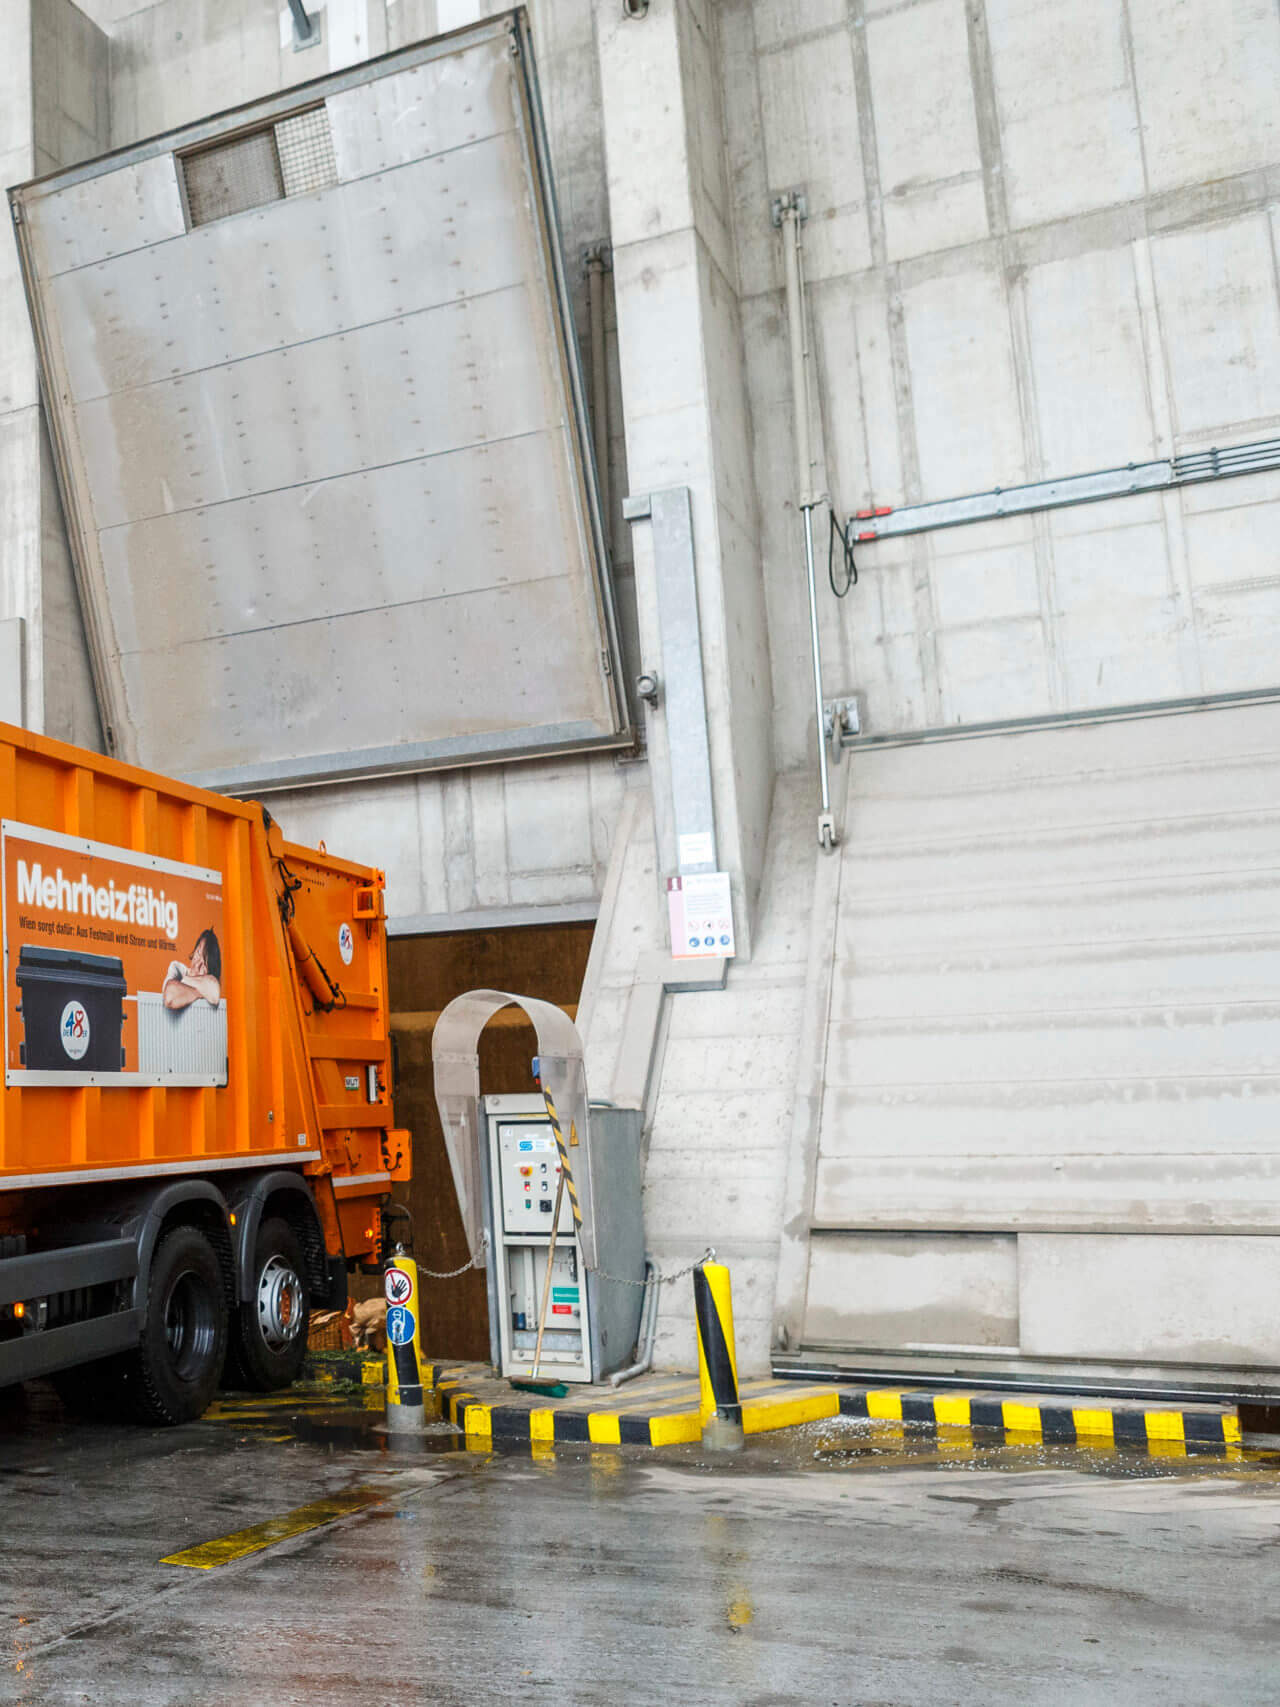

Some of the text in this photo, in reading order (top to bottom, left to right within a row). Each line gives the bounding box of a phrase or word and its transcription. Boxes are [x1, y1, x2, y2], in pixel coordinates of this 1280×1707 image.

[17, 859, 179, 940] Mehrheizfähig
[19, 915, 36, 931] Wien
[38, 920, 55, 937] sorgt
[76, 924, 89, 938] Aus
[115, 932, 129, 945] wird
[129, 933, 146, 947] Strom
[147, 937, 158, 949] und
[65, 1010, 85, 1038] 48
